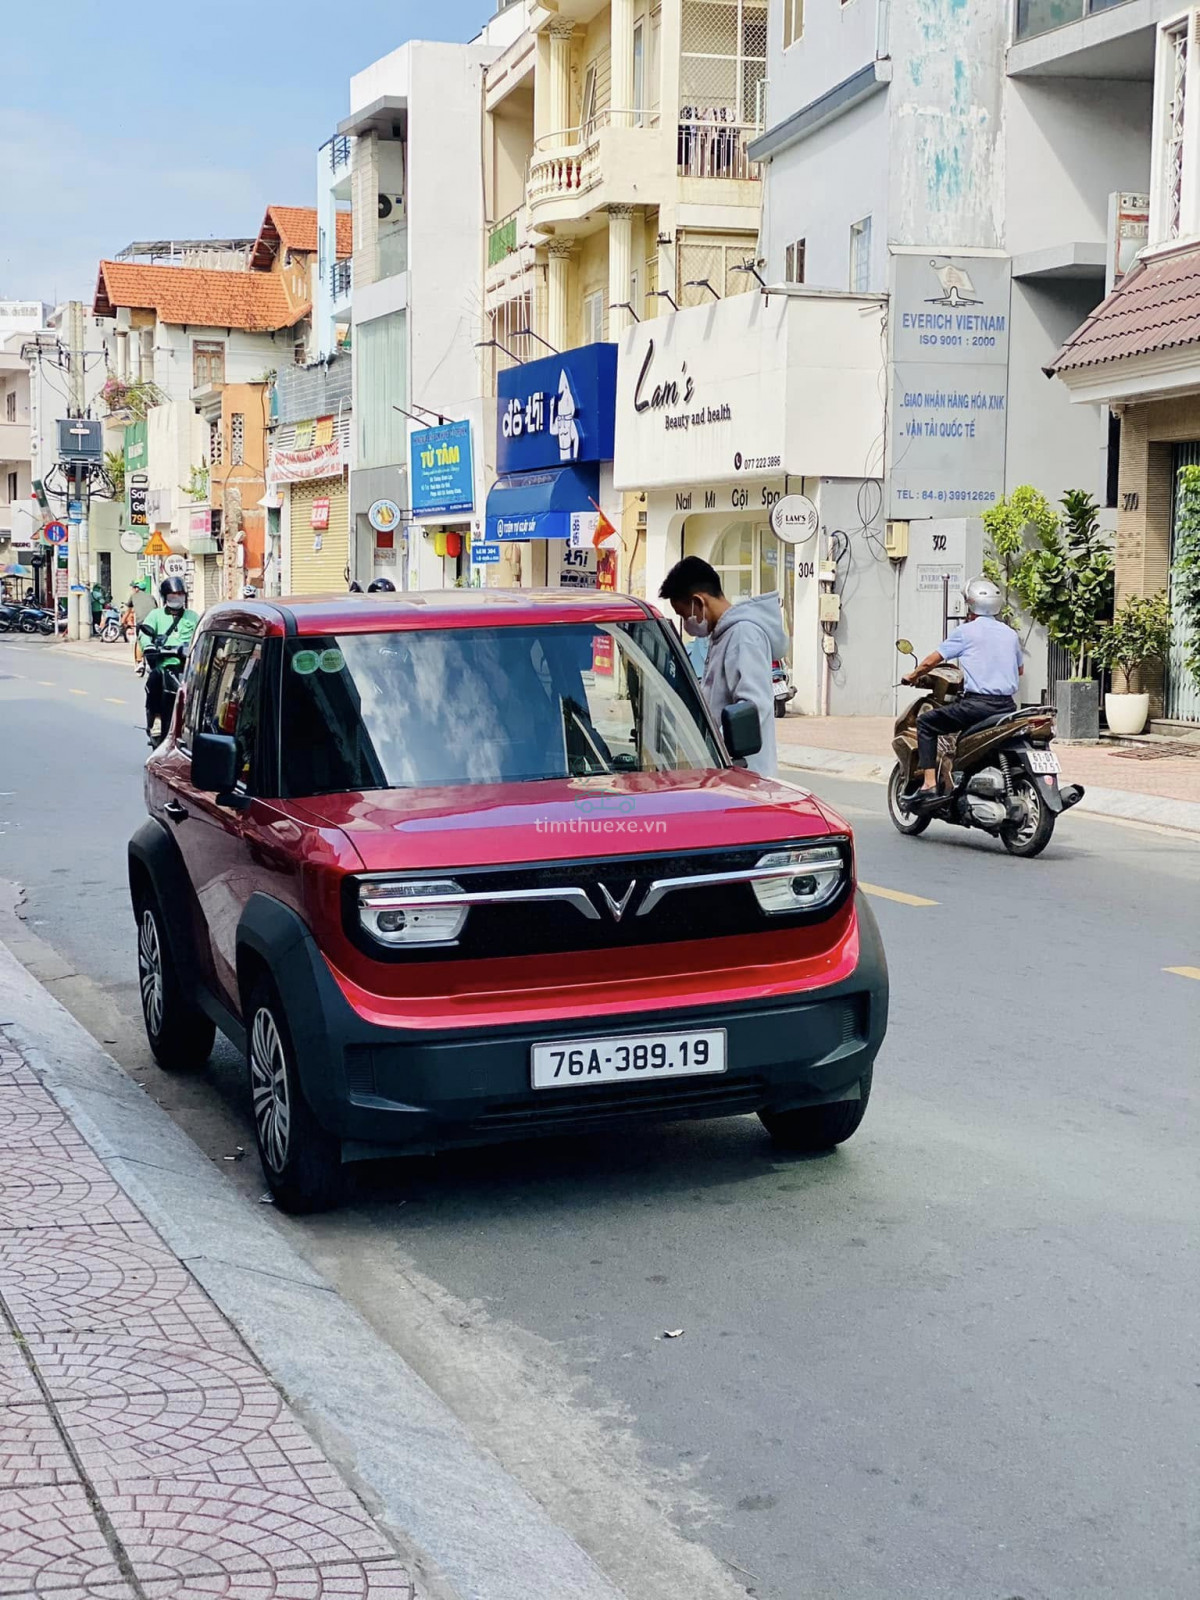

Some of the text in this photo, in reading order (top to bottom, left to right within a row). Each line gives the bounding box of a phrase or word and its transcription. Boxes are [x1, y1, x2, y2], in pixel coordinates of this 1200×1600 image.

[902, 313, 1005, 332] EVERICH VIETNAM
[920, 334, 938, 345] ISO
[940, 335, 962, 346] 9001
[972, 336, 996, 346] 2000
[634, 338, 694, 412] Lam's
[904, 392, 922, 408] GIAO
[988, 395, 1004, 410] XNK
[664, 404, 732, 431] Beauty and health
[744, 458, 754, 470] 077
[756, 458, 766, 468] 222
[676, 492, 692, 510] Nail
[732, 488, 748, 510] Gội
[762, 486, 780, 508] Spa
[896, 490, 914, 500] TEL
[949, 490, 996, 500] 39912626
[798, 562, 814, 578] 304
[550, 1039, 710, 1078] 76A-389.19
